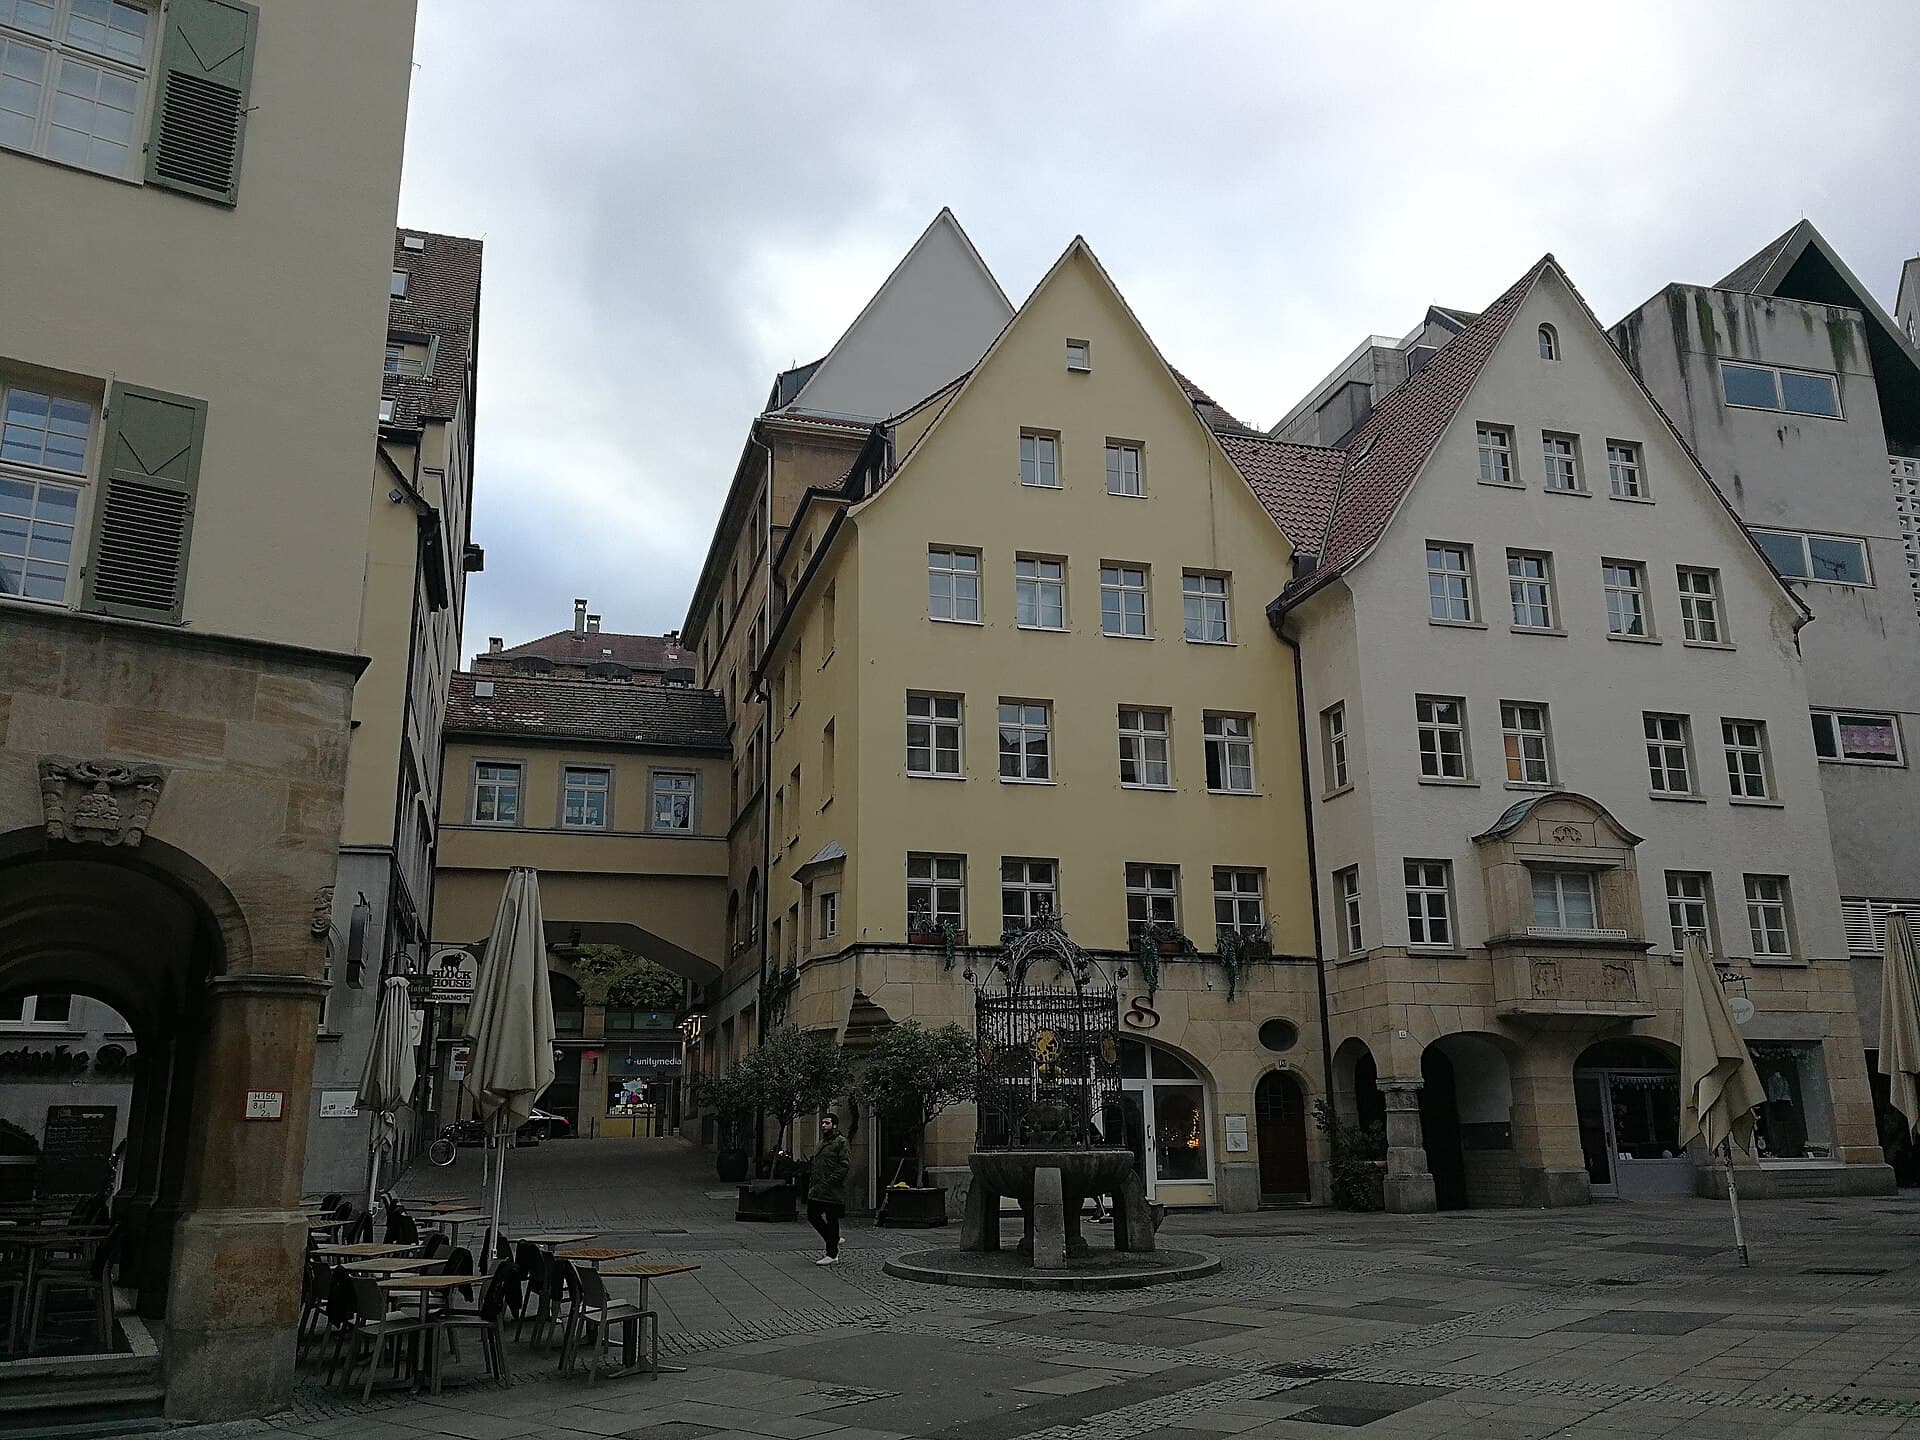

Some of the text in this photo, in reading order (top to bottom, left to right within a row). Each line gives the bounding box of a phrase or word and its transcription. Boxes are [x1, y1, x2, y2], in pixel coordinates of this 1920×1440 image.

[431, 970, 473, 979] BLOCK
[431, 979, 472, 988] HOUSE
[636, 1056, 682, 1068] unitymedia
